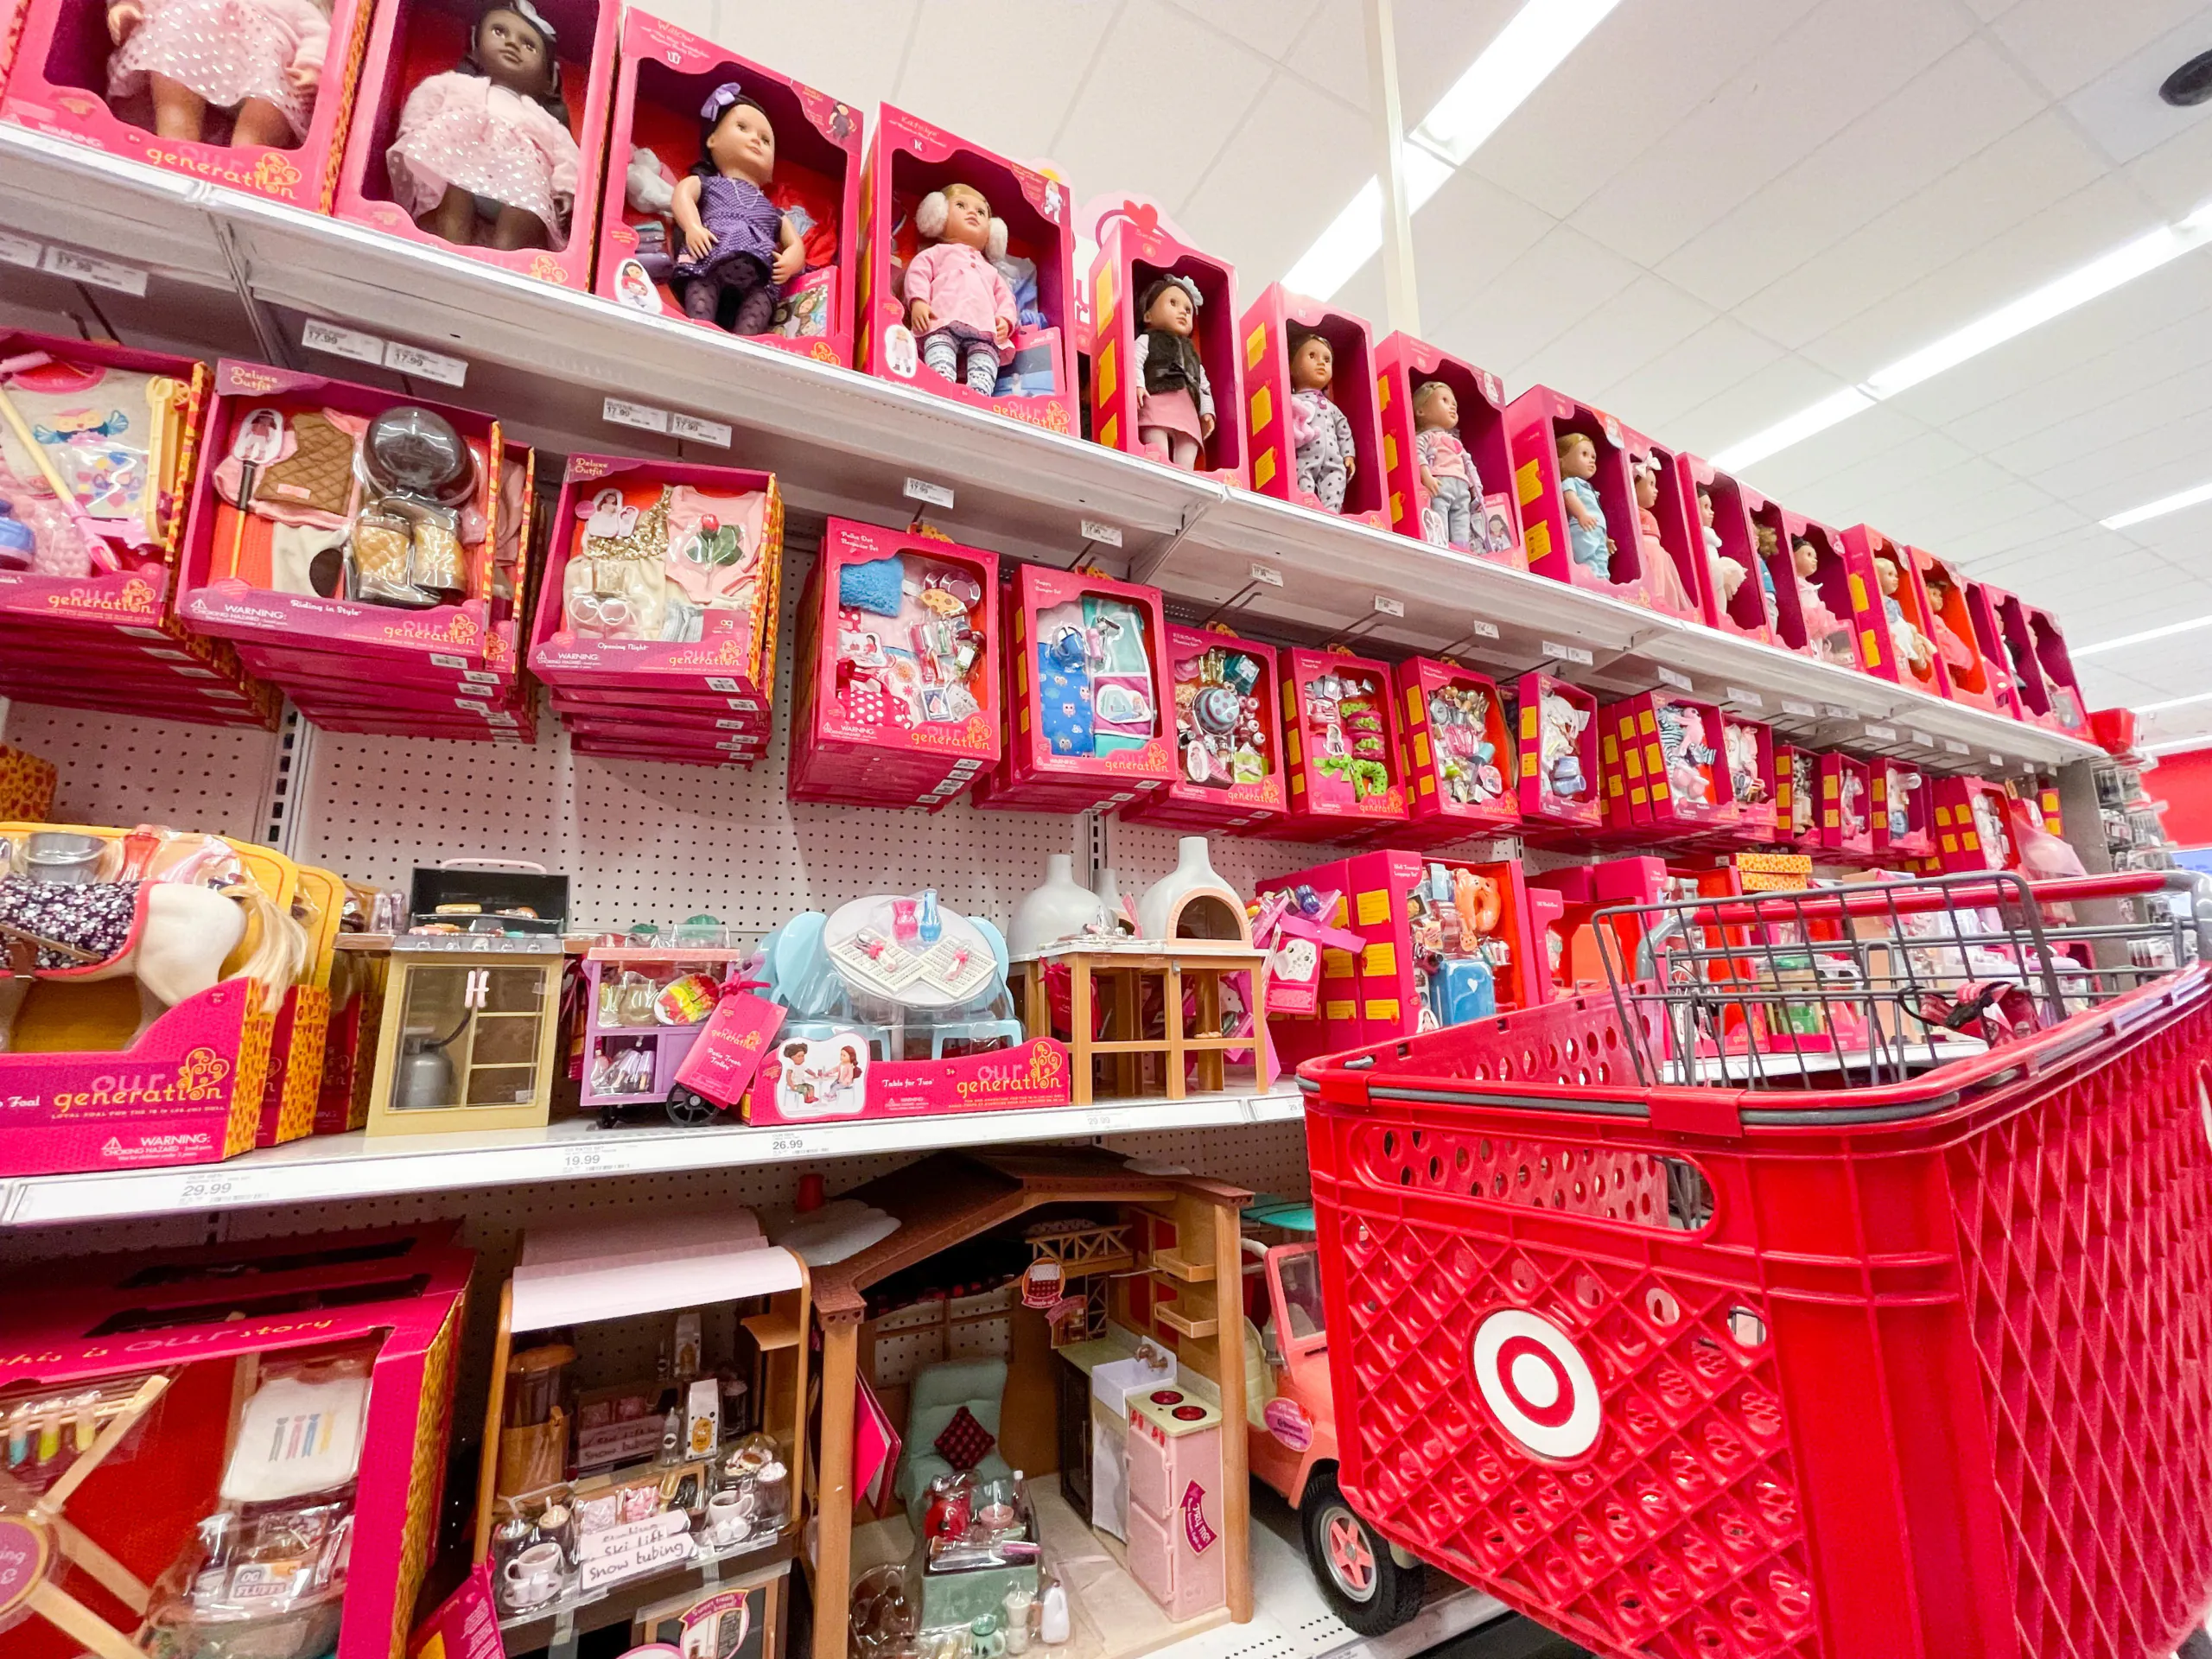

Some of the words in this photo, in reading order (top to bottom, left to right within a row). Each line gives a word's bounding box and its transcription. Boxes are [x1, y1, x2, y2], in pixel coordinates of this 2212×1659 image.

[146, 148, 298, 200] generation
[308, 331, 338, 345] 17.99
[395, 353, 423, 367] 17.99
[230, 375, 271, 391] Outfit
[231, 366, 277, 384] Deluxe
[993, 404, 1069, 435] generation
[575, 457, 608, 468] Deluxe
[575, 465, 603, 476] Outfit
[48, 594, 155, 614] generation
[225, 604, 287, 620] WARNING:
[290, 598, 324, 613] Riding
[325, 604, 335, 613] in
[384, 626, 476, 646] generation
[597, 642, 626, 652] Opening
[627, 643, 647, 652] Night
[669, 655, 741, 666] generation
[911, 732, 991, 751] generation
[1105, 760, 1169, 772] generation
[1228, 791, 1281, 804] generation
[1359, 804, 1405, 815] generation
[711, 1029, 756, 1052] generation
[977, 1064, 1023, 1081] our
[91, 1073, 167, 1093] our
[882, 1078, 904, 1088] Table
[905, 1078, 916, 1087] for
[917, 1077, 933, 1086] Two
[957, 1073, 1061, 1099] generation
[8, 1096, 41, 1108] Foal
[54, 1083, 223, 1113] generation
[141, 1133, 211, 1147] WARNING:
[772, 1139, 804, 1150] 26.99
[564, 1154, 601, 1166] 19.99
[181, 1182, 232, 1198] 29.99
[239, 1319, 334, 1338] story
[636, 1541, 683, 1565] tubing
